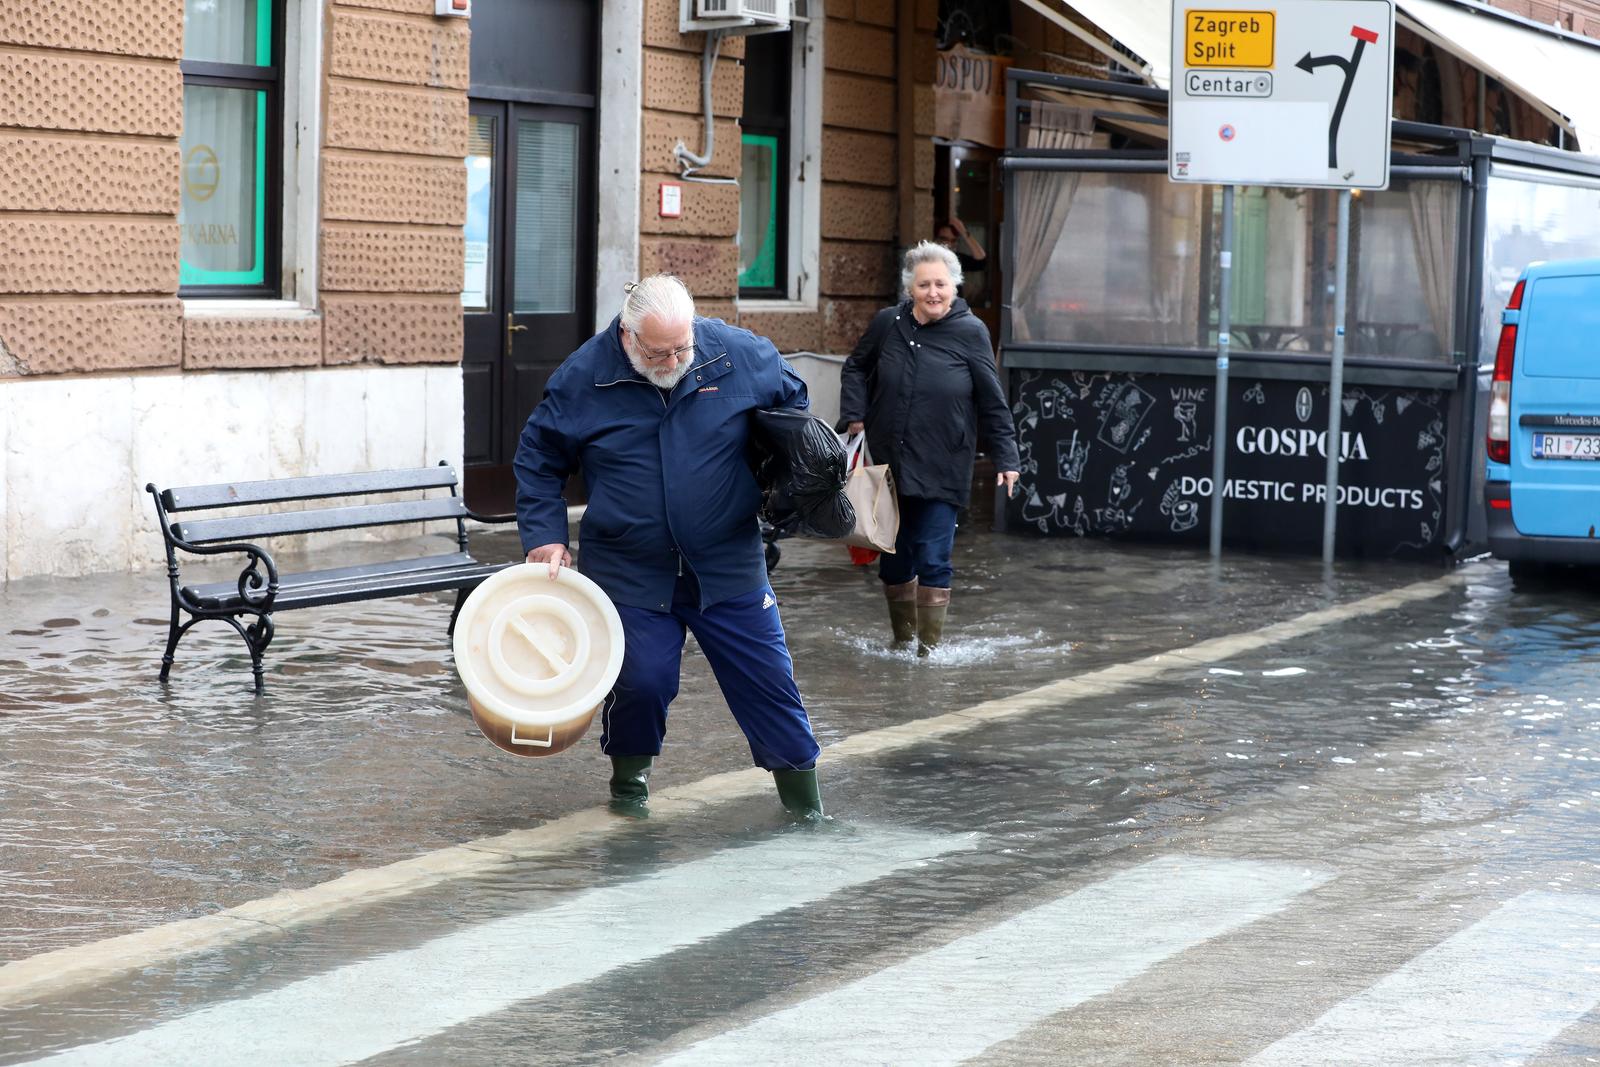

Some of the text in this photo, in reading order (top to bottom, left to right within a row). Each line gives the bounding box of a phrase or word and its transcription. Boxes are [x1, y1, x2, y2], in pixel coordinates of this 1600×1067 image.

[1194, 16, 1260, 37] Zagreb
[1193, 41, 1236, 62] Split
[1190, 75, 1253, 92] Centar
[1170, 387, 1209, 402] WINE
[1544, 437, 1561, 453] RI
[1181, 476, 1424, 509] DOMESTIC PRODUCTS
[1093, 507, 1127, 528] TEA
